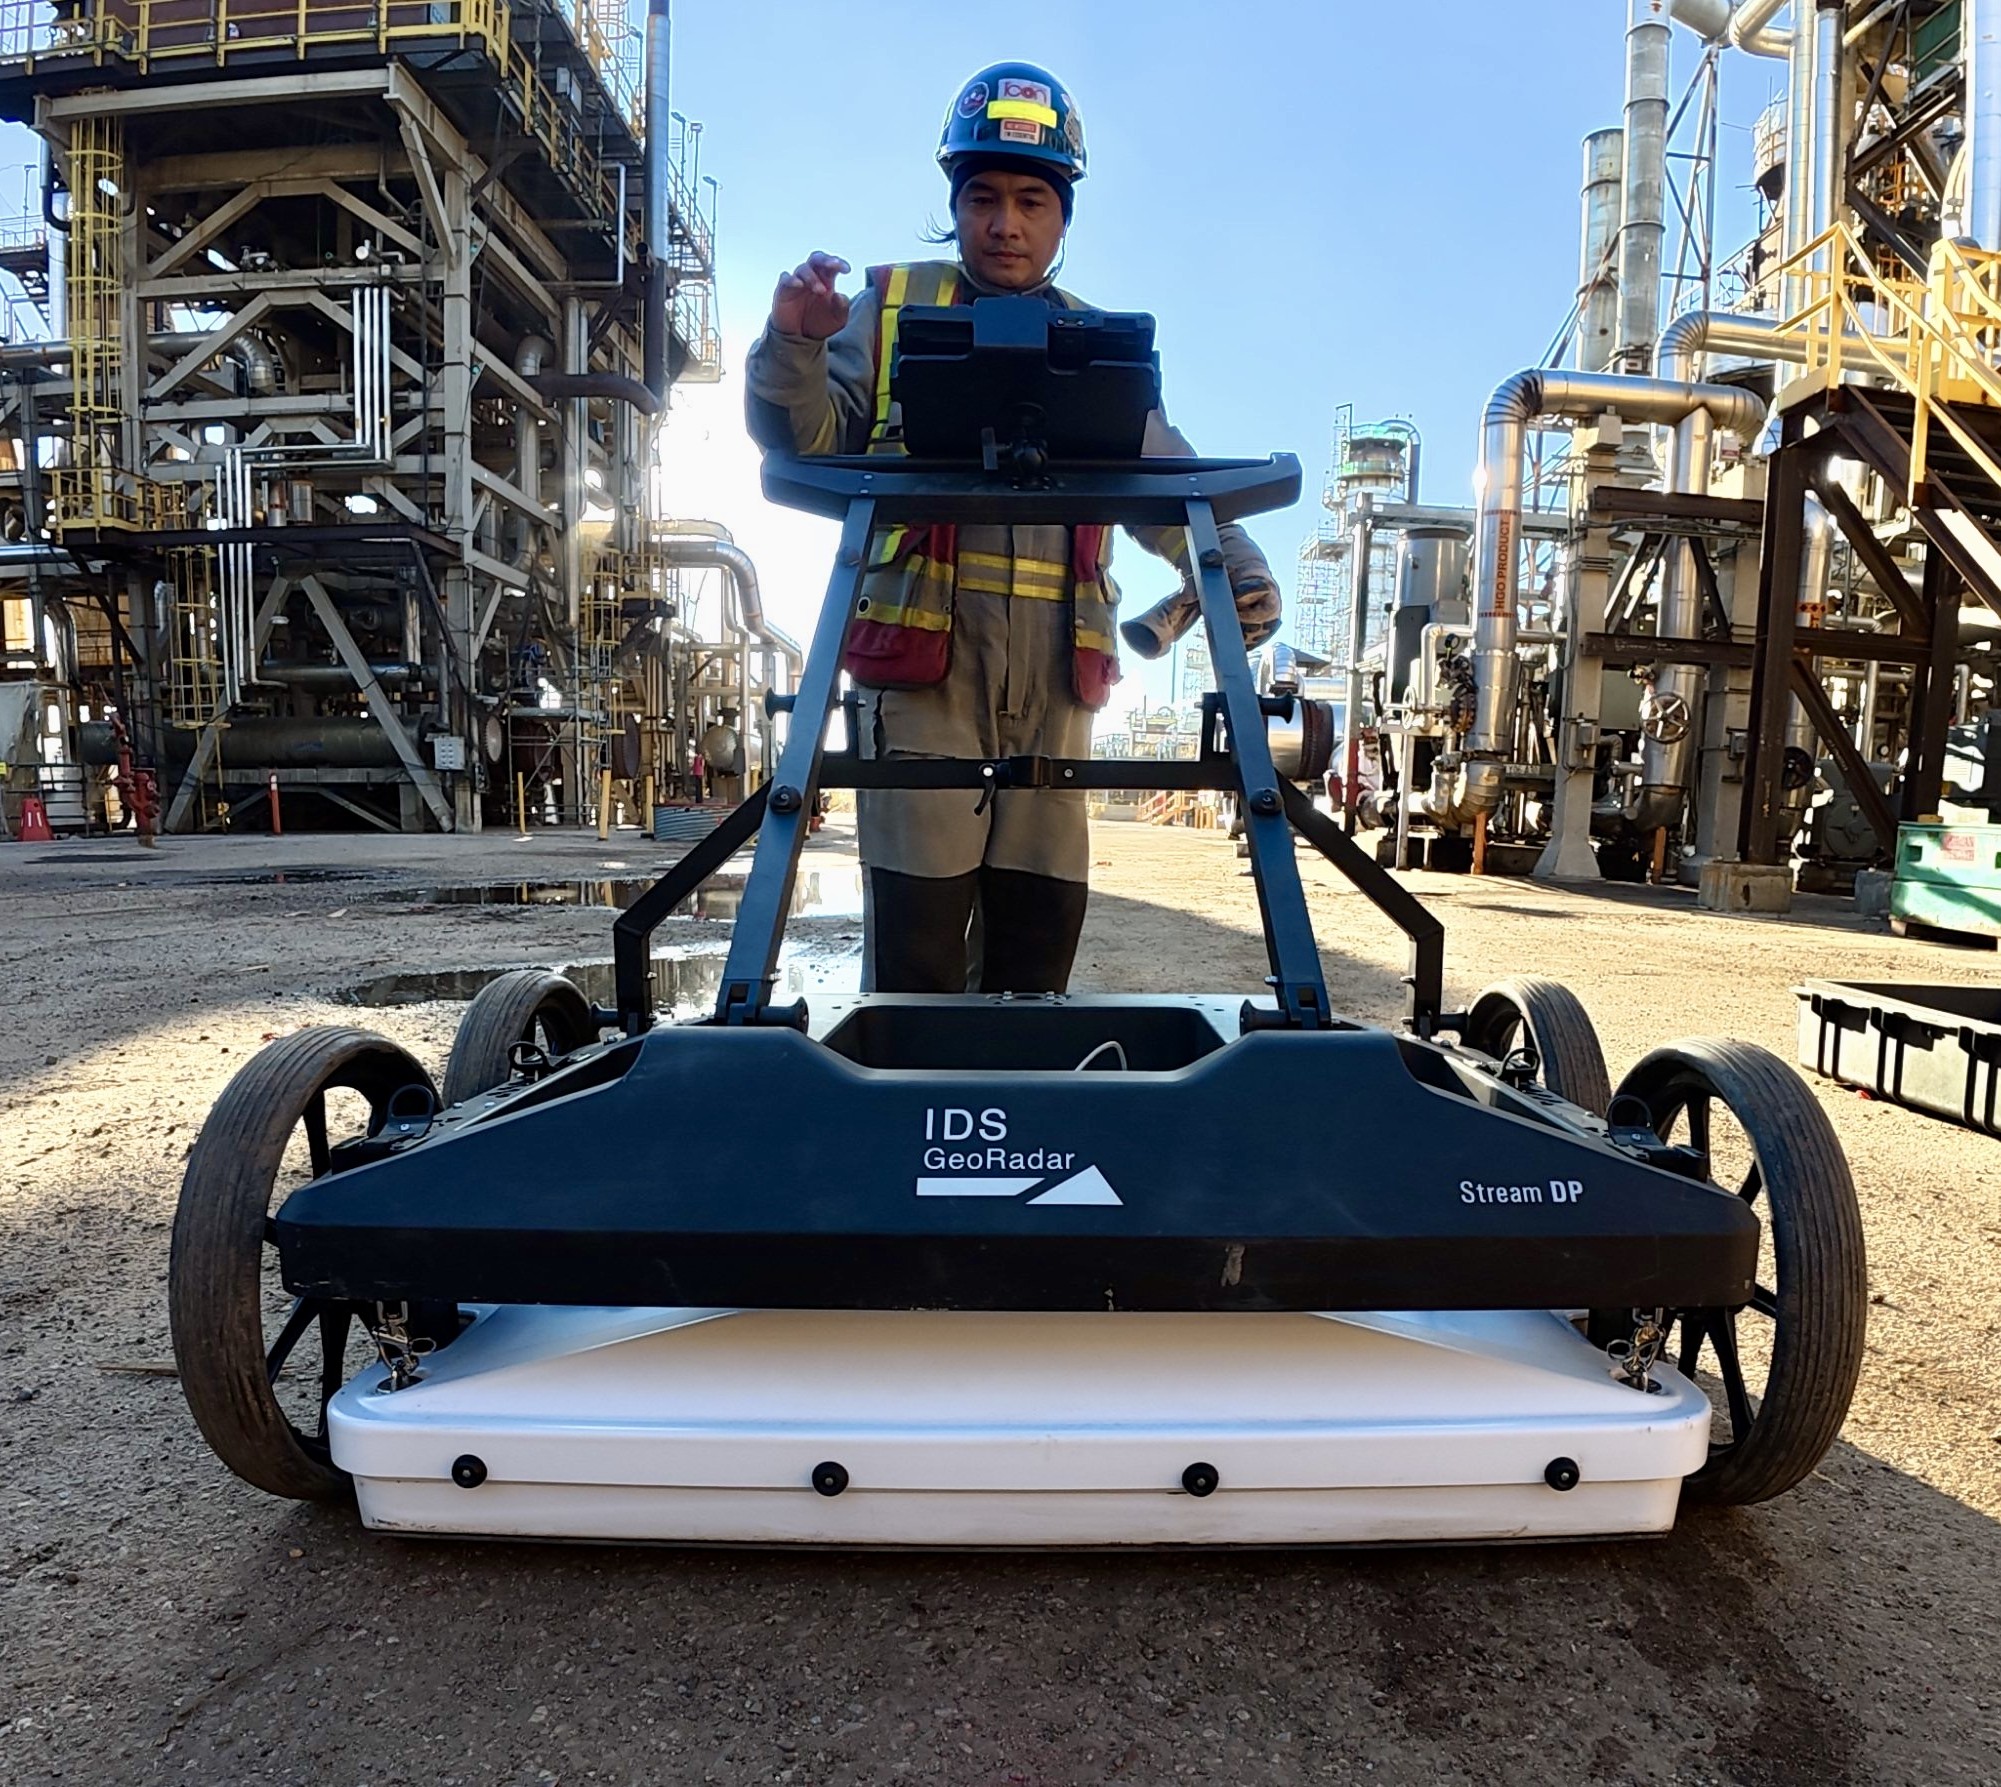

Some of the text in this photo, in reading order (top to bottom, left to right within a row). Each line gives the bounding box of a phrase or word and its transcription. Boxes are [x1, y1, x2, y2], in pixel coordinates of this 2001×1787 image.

[1495, 520, 1510, 609] HGO PRODUCT
[925, 1108, 1008, 1141] IDS
[923, 1147, 1076, 1170] GeoRadar
[1459, 1180, 1584, 1204] Stream DP
